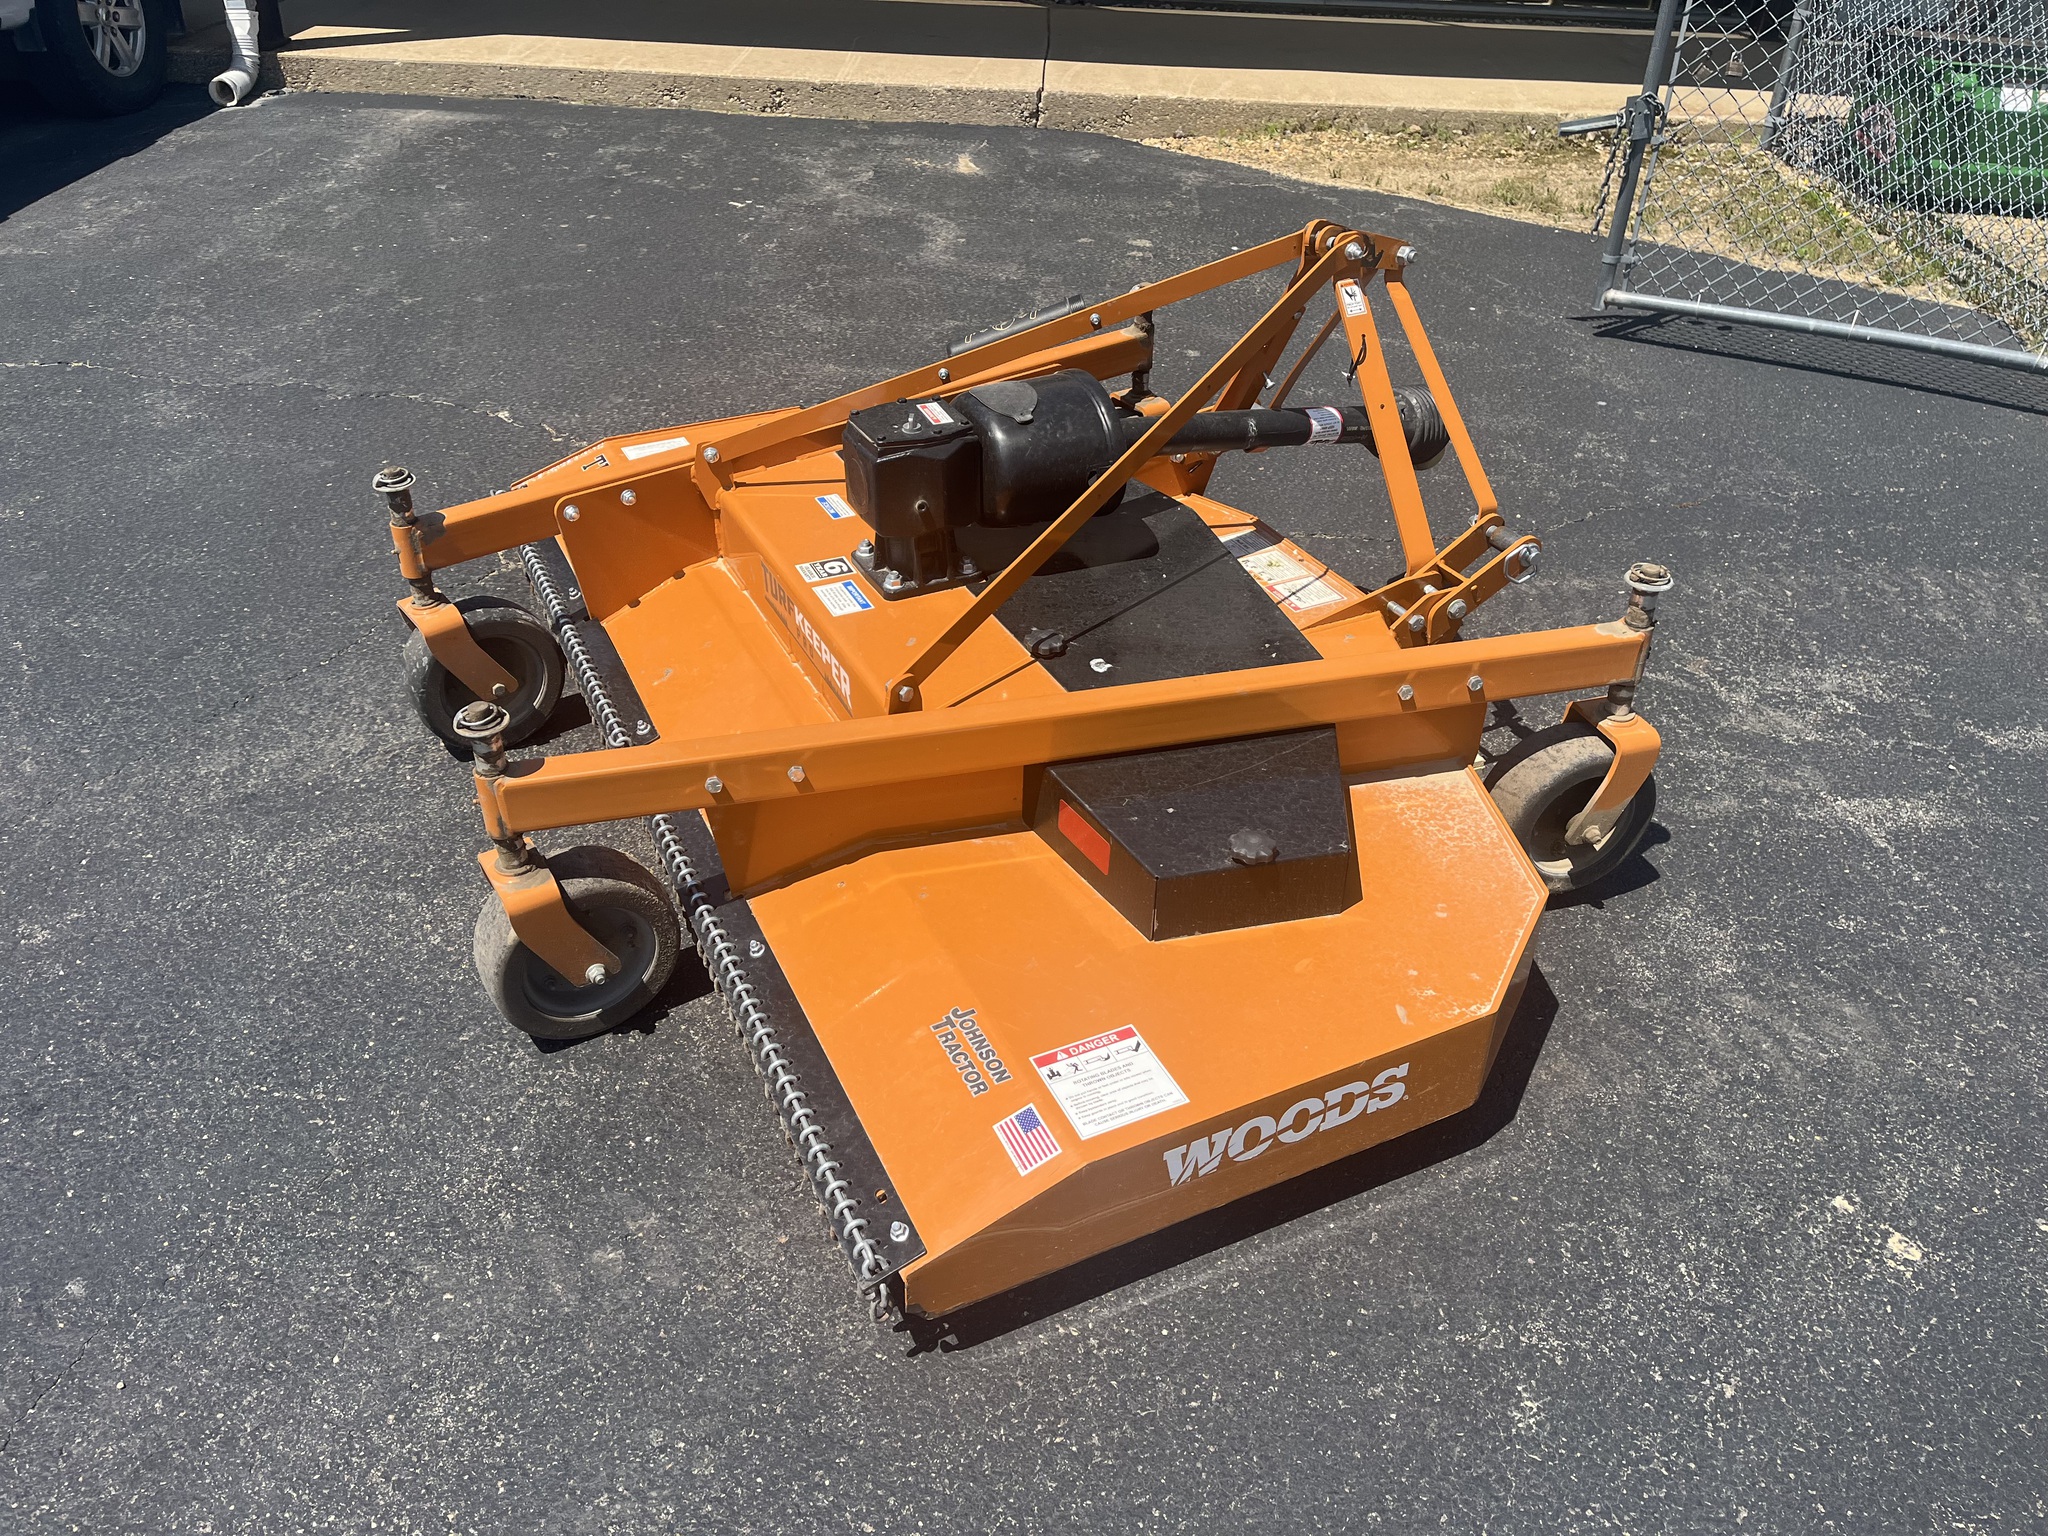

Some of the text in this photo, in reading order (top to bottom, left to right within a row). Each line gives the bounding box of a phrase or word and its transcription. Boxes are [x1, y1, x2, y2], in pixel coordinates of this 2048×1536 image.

[812, 562, 829, 578] YEAR
[823, 560, 849, 575] 6
[931, 1015, 989, 1096] TRACTOR
[950, 1007, 1012, 1084] JOHNSON
[1069, 1033, 1120, 1056] DANGER
[1073, 1071, 1100, 1085] ROTATING
[1163, 1062, 1410, 1188] WOODS
